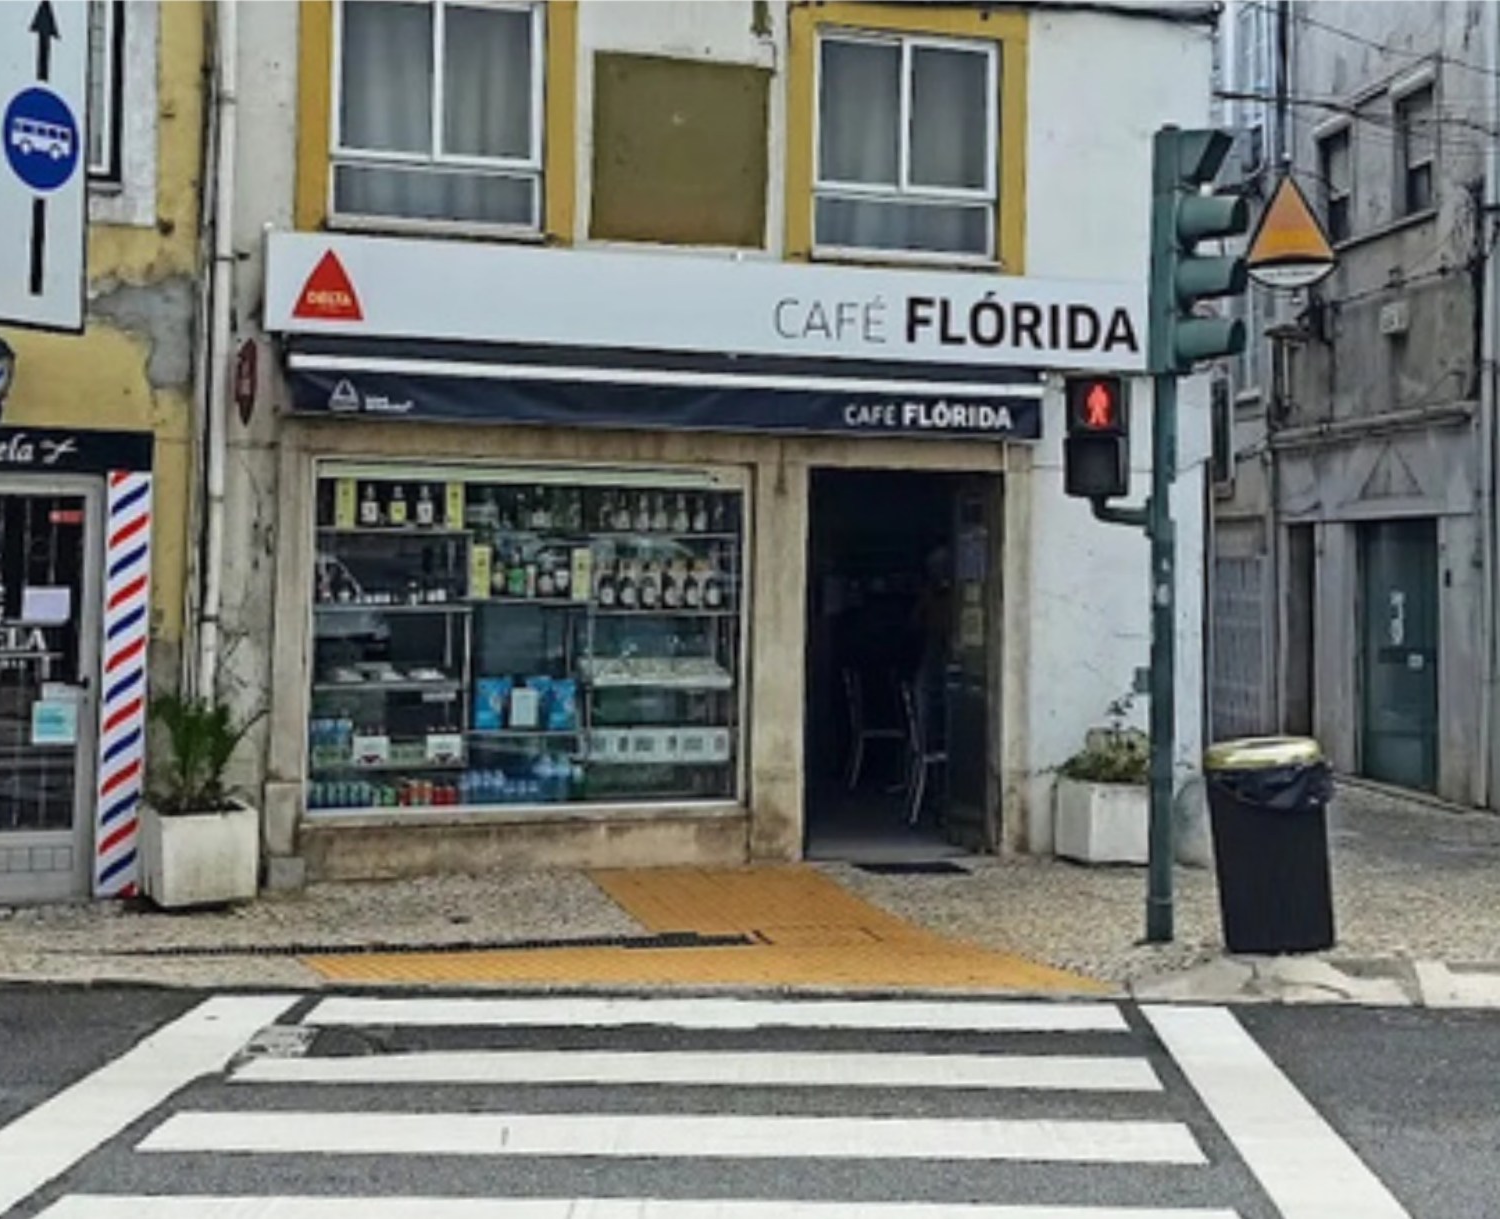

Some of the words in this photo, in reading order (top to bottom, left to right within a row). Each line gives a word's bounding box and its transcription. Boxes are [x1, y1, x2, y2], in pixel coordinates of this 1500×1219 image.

[306, 291, 352, 305] DELTA
[774, 295, 887, 343] CAFÉ
[906, 291, 1139, 352] FLÓRIDA
[845, 402, 896, 425] CAFÉ
[902, 401, 1013, 429] FLÓRIDA
